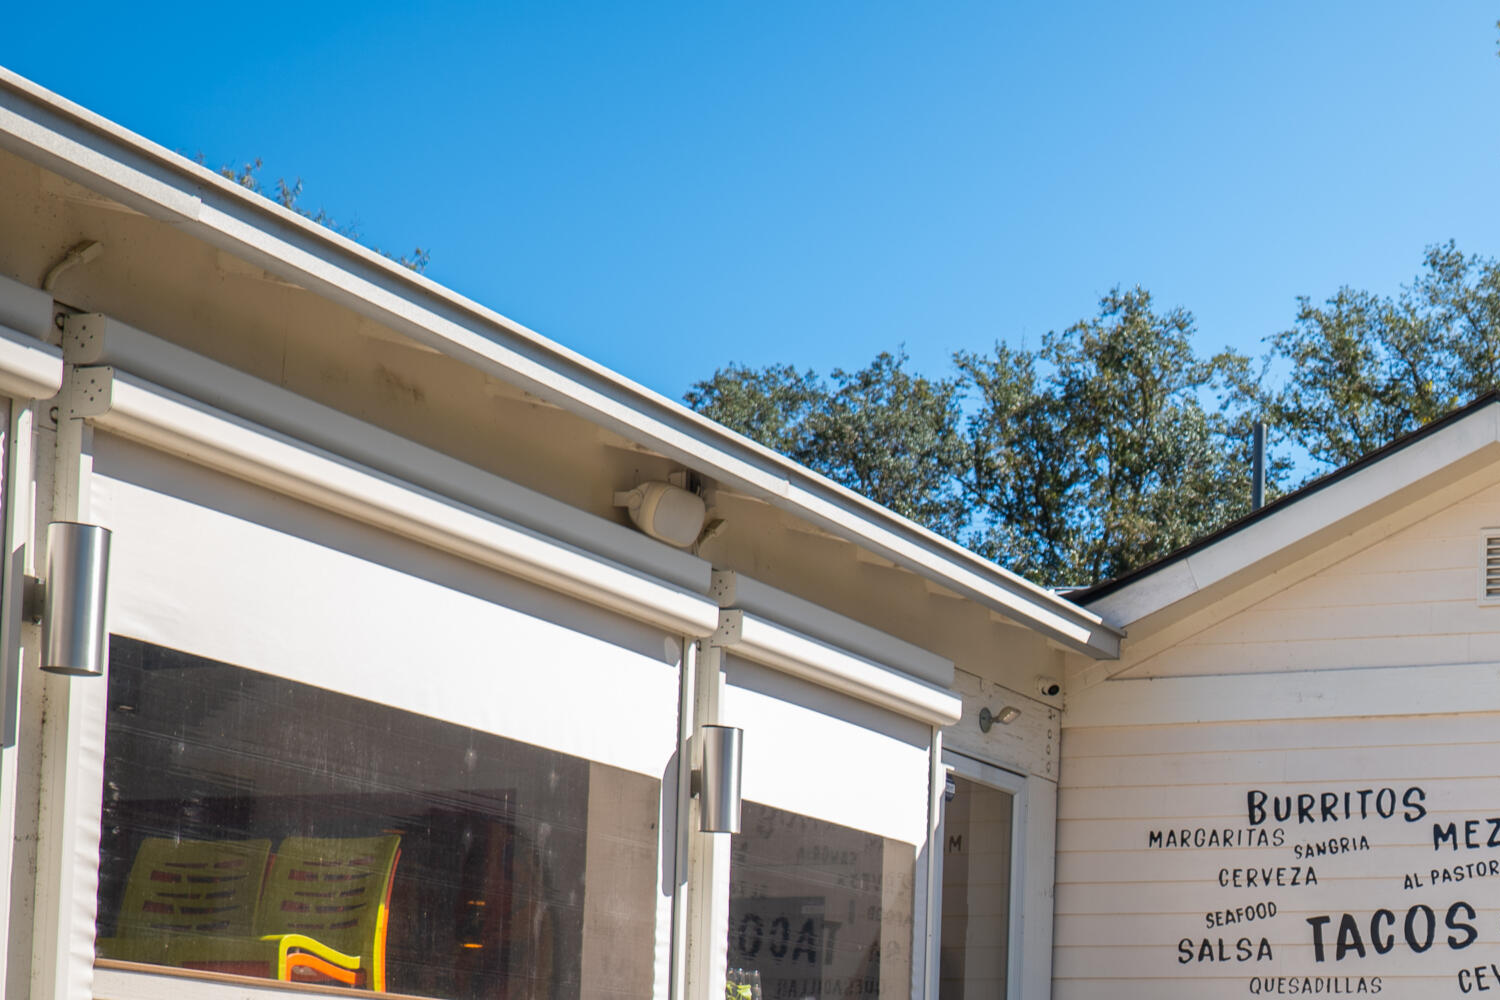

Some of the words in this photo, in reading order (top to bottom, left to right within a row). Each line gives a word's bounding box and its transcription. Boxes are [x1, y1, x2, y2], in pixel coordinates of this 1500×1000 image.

[1246, 786, 1427, 826] BURRITOS
[1148, 828, 1285, 849] MARGARITAS
[1294, 835, 1370, 859] SANGRIA
[1218, 866, 1318, 888] CERVEZA
[1403, 873, 1424, 890] AL
[1430, 859, 1500, 886] PASTOR
[1205, 901, 1277, 929] SEAFOOD
[1305, 901, 1478, 963] TACOS
[1177, 937, 1273, 965] SALSA
[1249, 976, 1382, 995] QUESADILLAS
